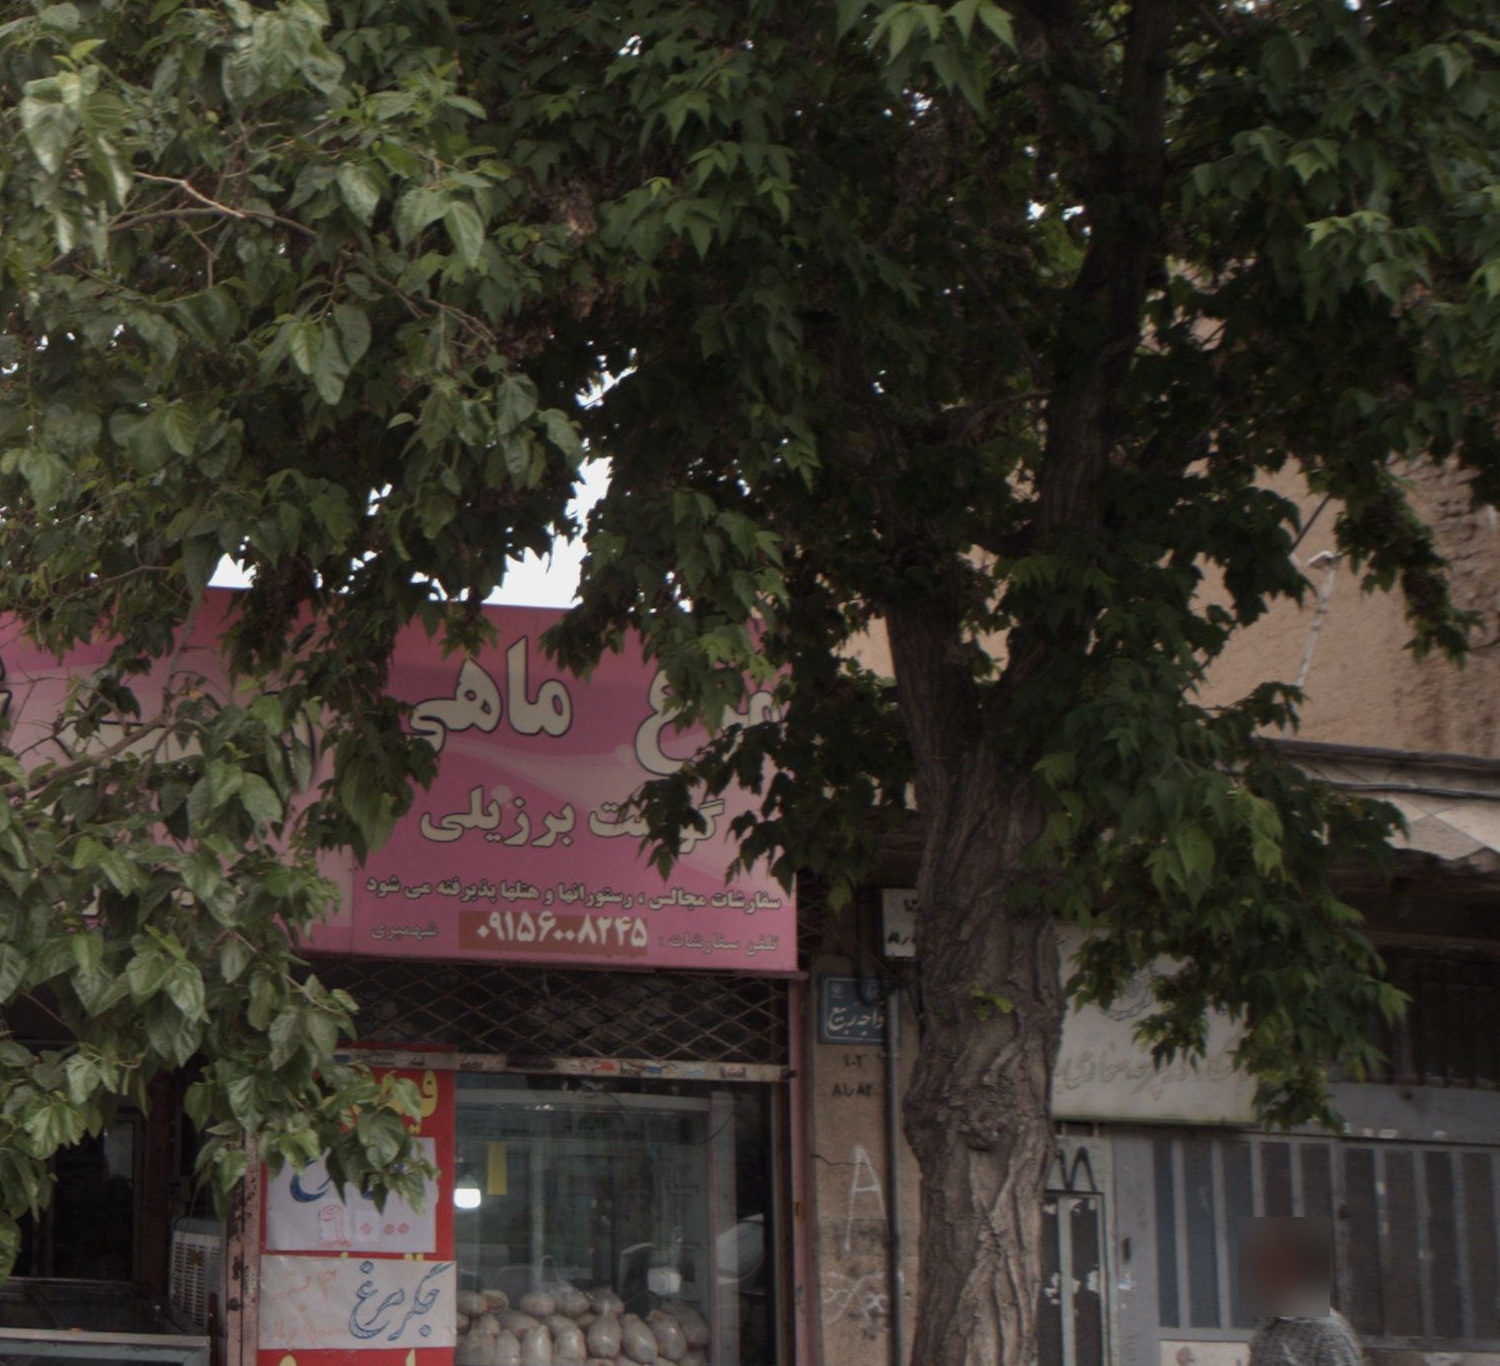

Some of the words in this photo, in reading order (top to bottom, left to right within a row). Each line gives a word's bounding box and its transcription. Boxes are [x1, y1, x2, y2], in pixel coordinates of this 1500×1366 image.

[409, 635, 573, 754] ماهی
[420, 785, 576, 847] برزیلی
[366, 875, 400, 896] شود
[405, 881, 431, 901] می
[436, 880, 496, 905] پذیرفته
[499, 881, 539, 902] هتلها
[545, 889, 555, 906] و
[558, 883, 633, 910] رستورانها
[711, 888, 782, 914] سفارشات
[347, 1259, 406, 1341] مرغ
